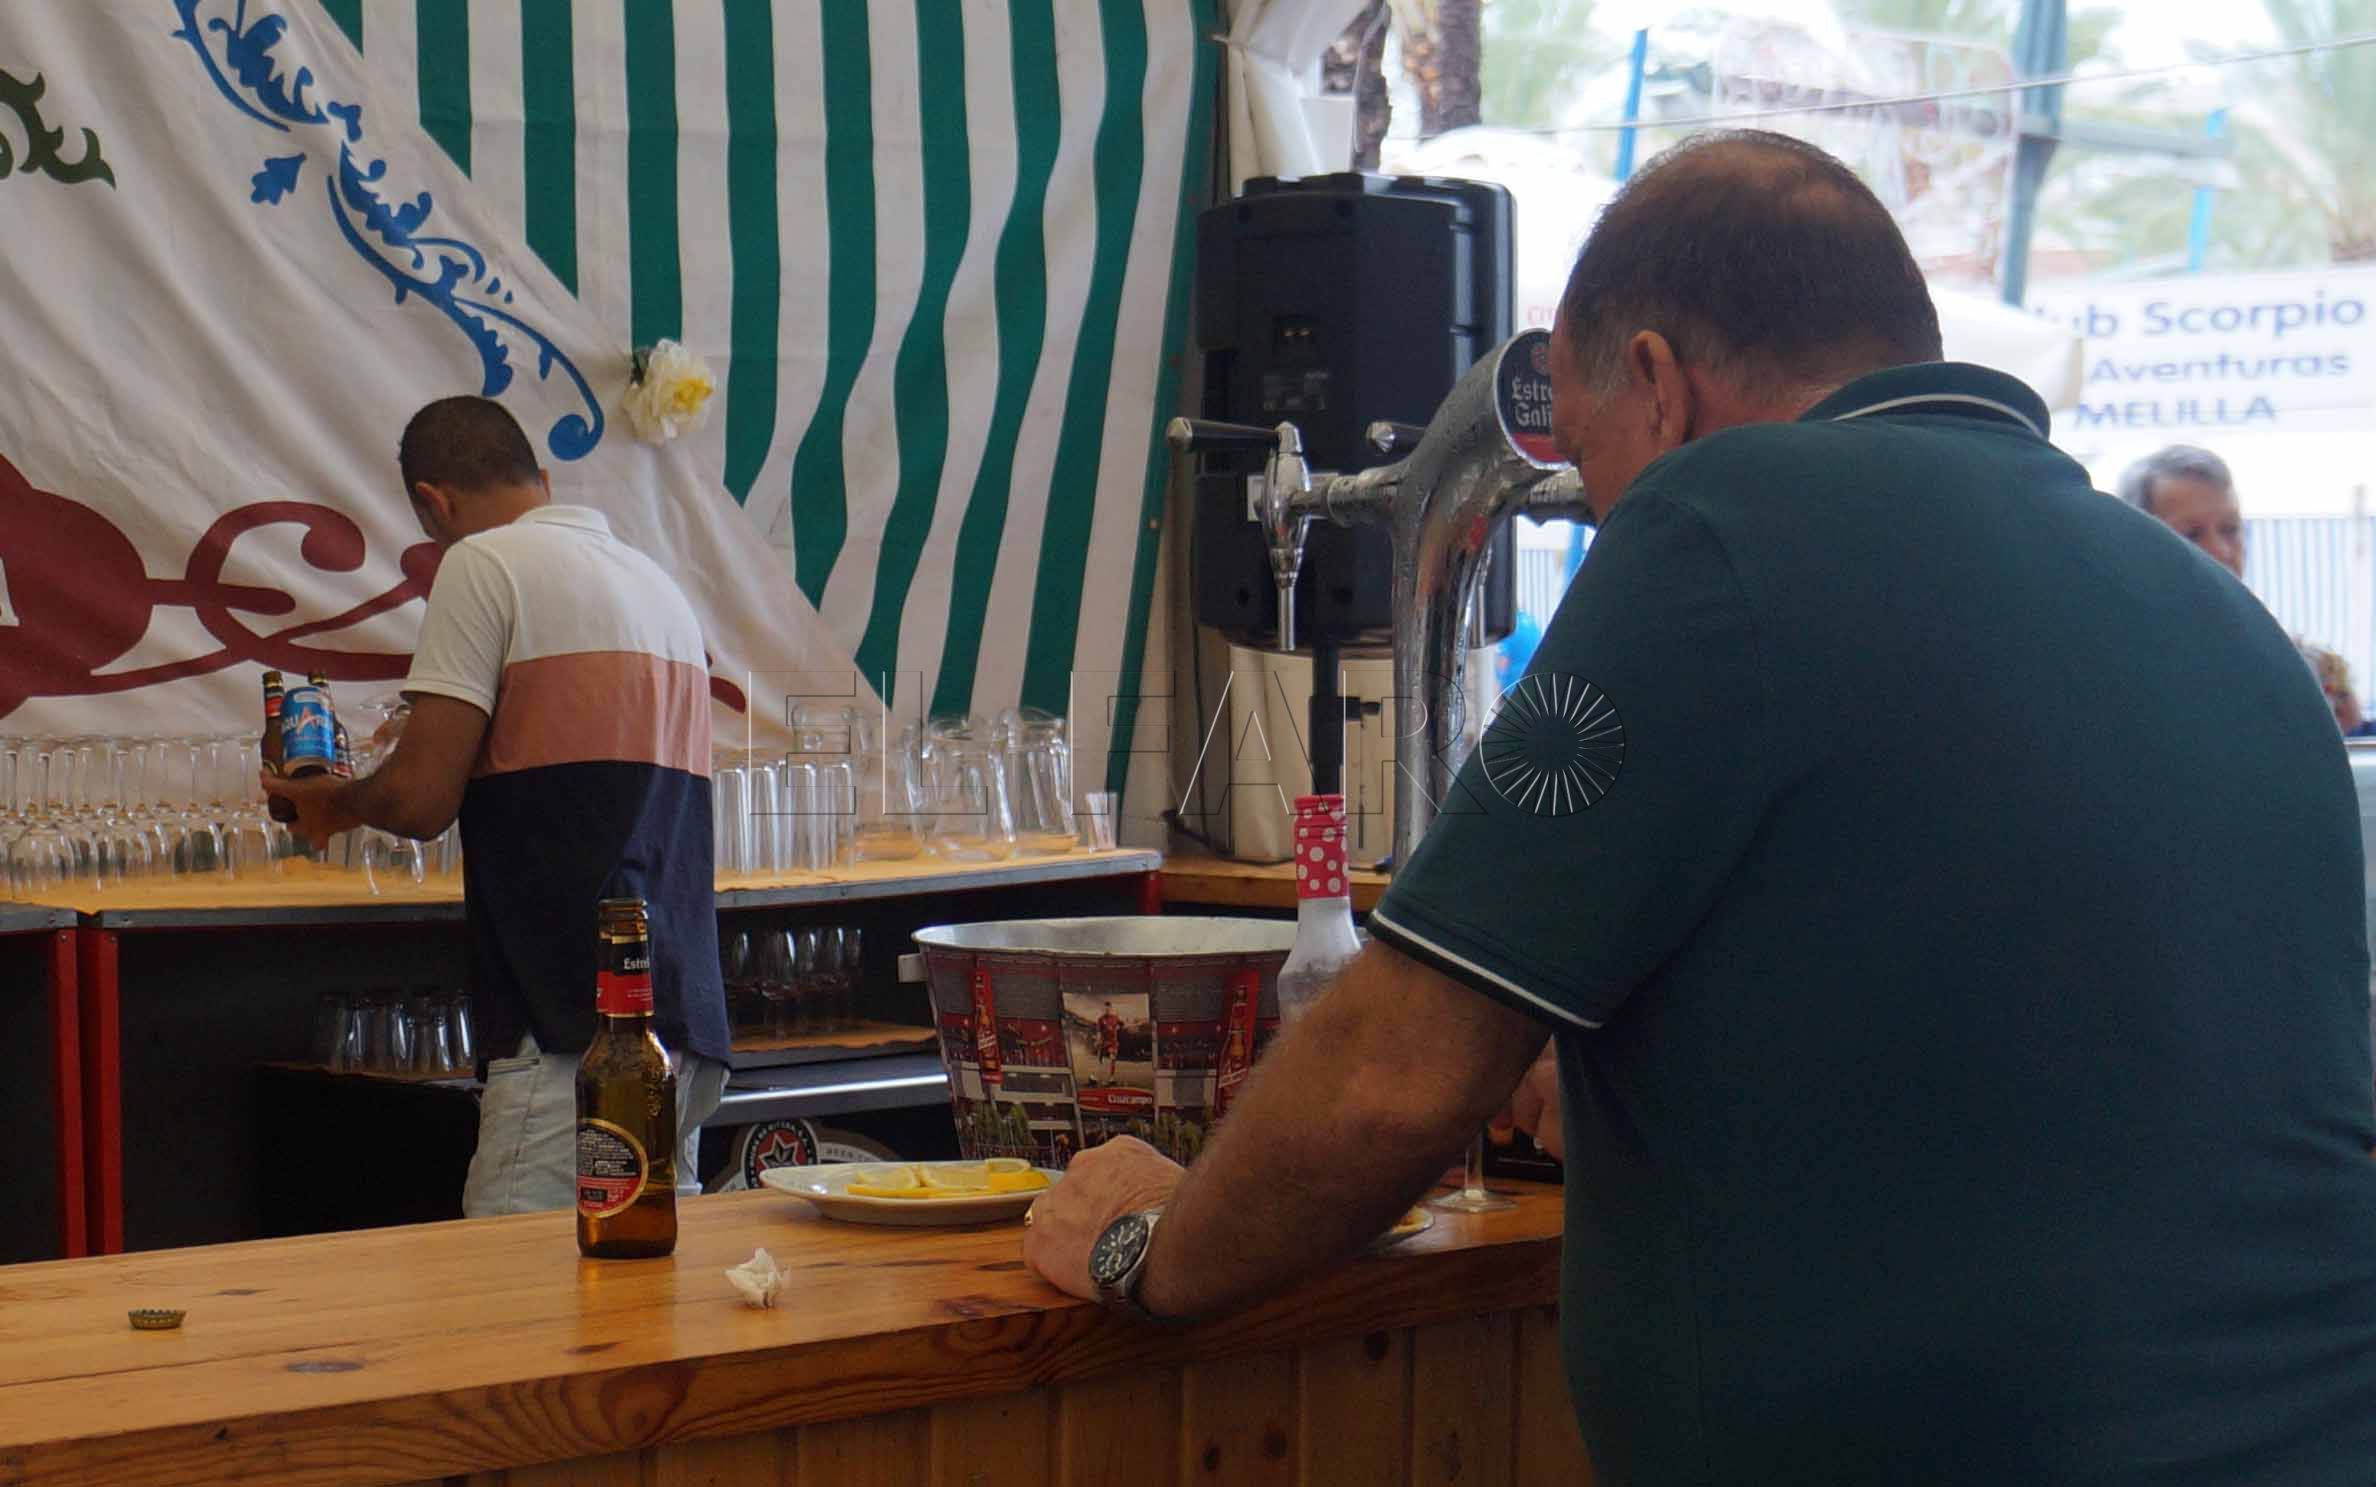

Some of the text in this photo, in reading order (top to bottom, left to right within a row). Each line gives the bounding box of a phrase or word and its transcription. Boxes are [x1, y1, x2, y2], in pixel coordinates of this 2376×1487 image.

[2143, 290, 2366, 336] Scorpio
[2089, 353, 2350, 382] Aventuras
[2075, 396, 2276, 428] MELILLA
